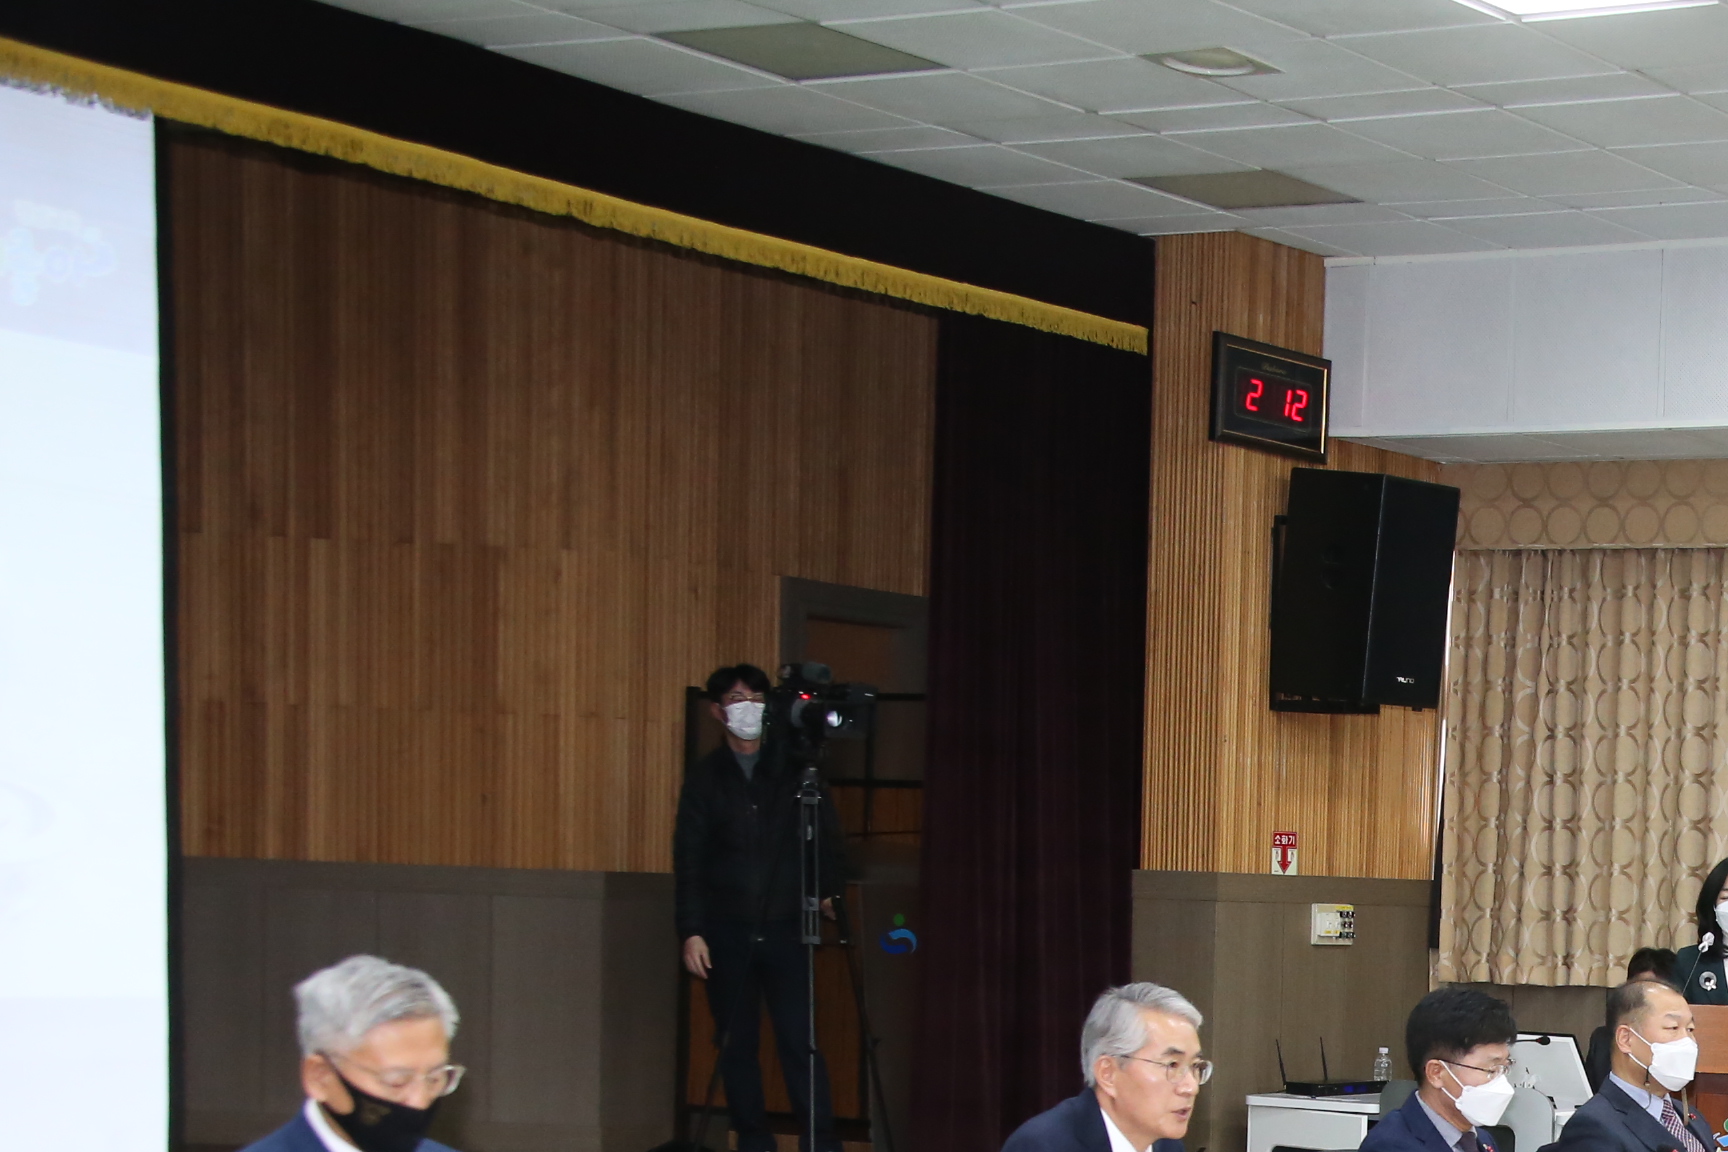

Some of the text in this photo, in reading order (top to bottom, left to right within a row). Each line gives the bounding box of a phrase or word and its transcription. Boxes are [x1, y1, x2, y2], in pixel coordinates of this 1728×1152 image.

[1246, 379, 1309, 422] 2 12
[1274, 834, 1296, 846] 소화기
